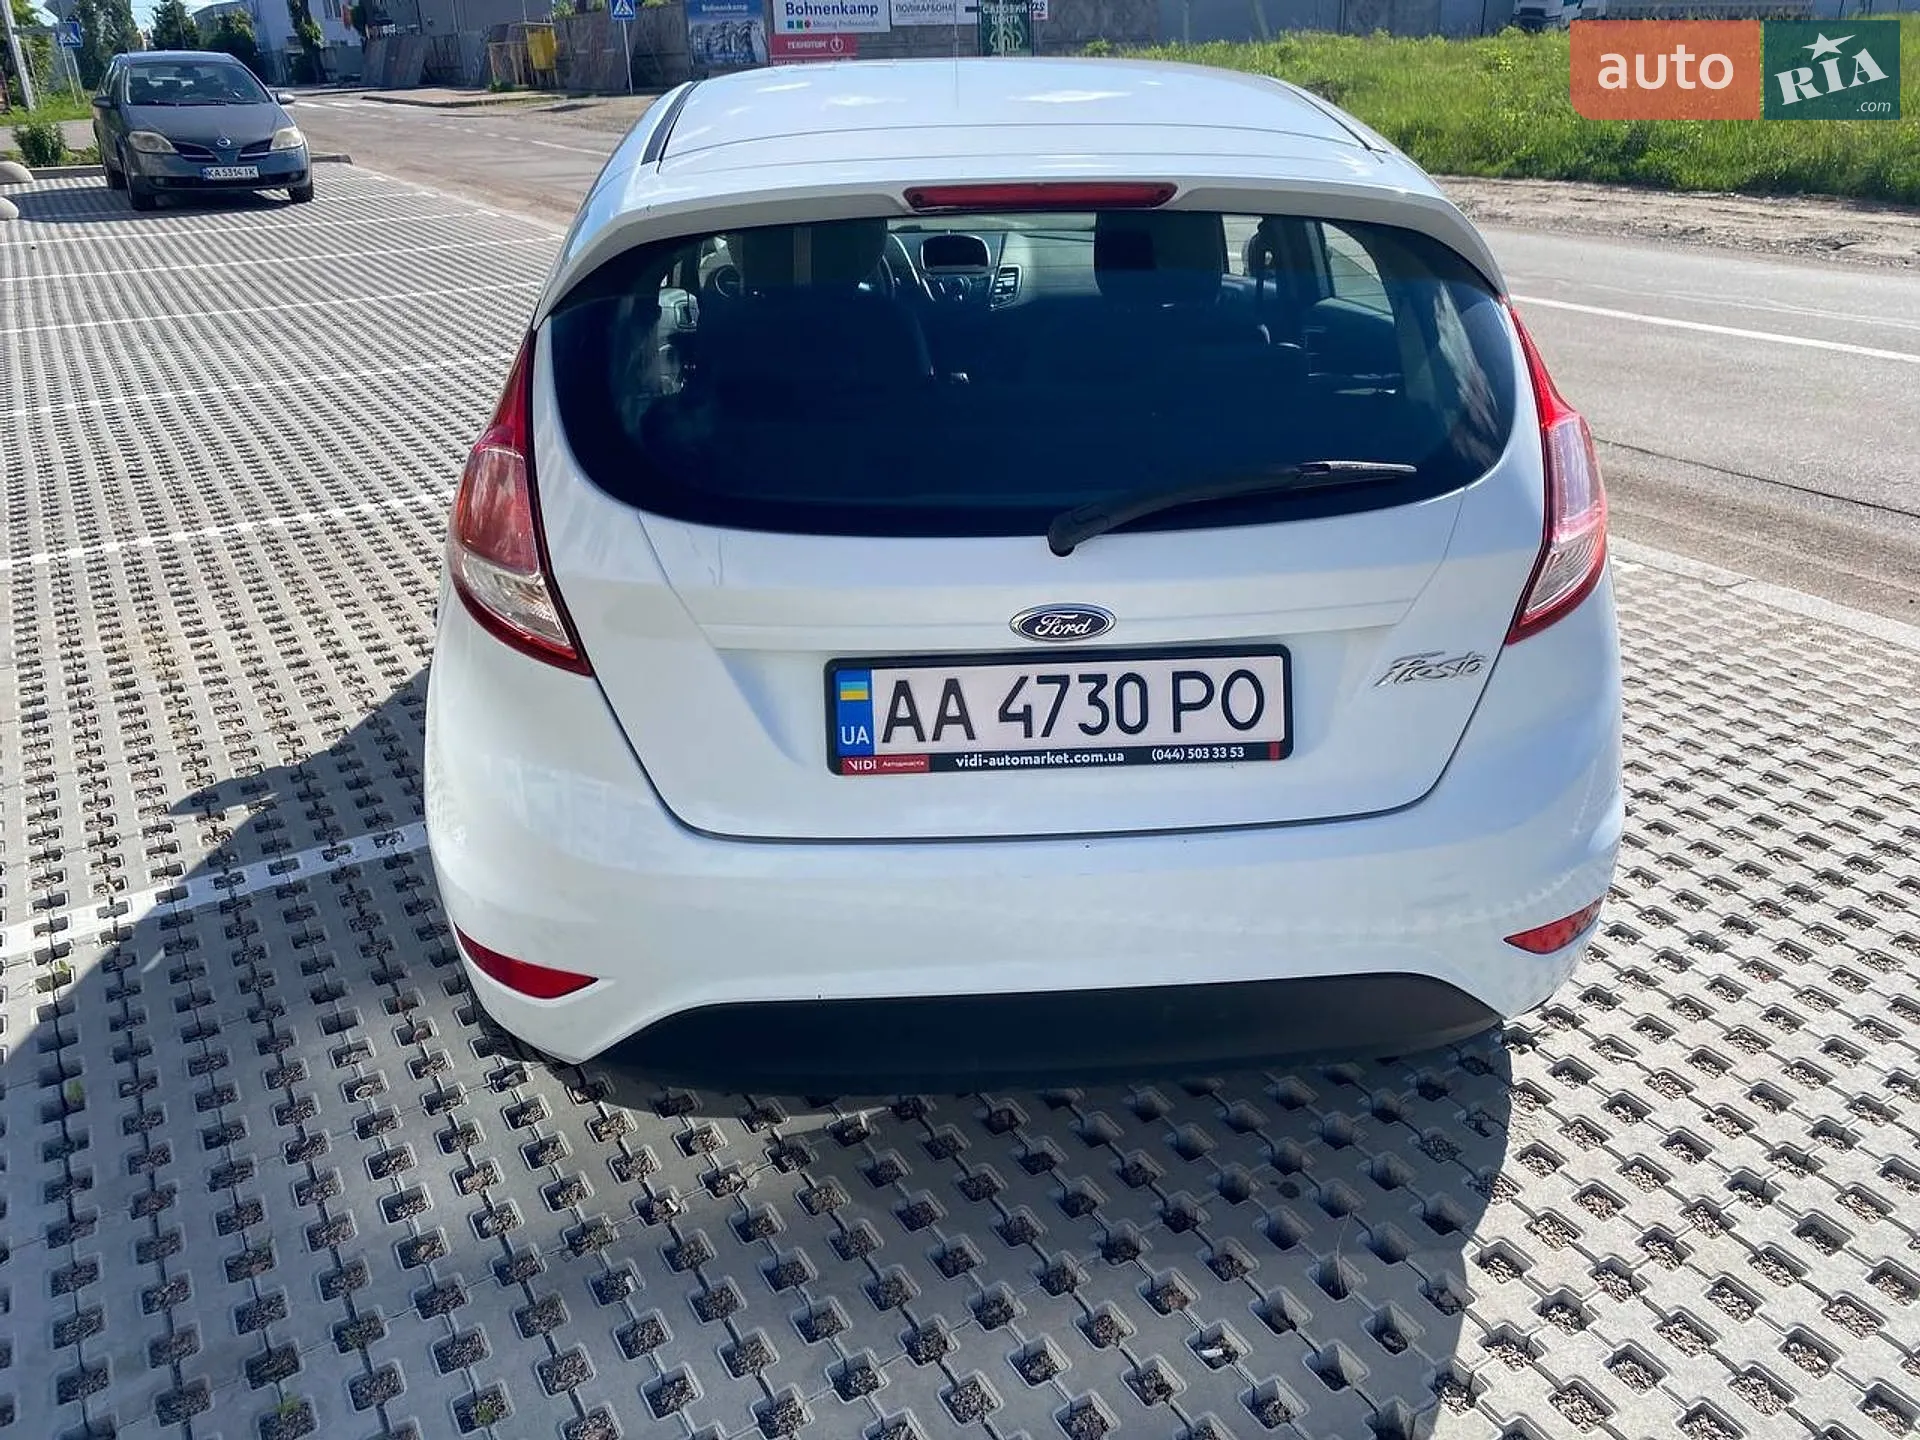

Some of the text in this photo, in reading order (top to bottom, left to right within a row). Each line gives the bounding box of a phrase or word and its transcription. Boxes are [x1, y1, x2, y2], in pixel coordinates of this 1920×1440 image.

[785, 2, 878, 17] Bohnenkamp
[1035, 613, 1092, 635] Ford
[1374, 651, 1486, 687] Fiesta
[882, 669, 1265, 743] AA 4730 PO
[841, 726, 870, 745] UA
[955, 752, 1125, 769] vidi-automarket.com.ua
[1152, 746, 1245, 761] (044) 503 33 53
[848, 759, 877, 771] VIDI
